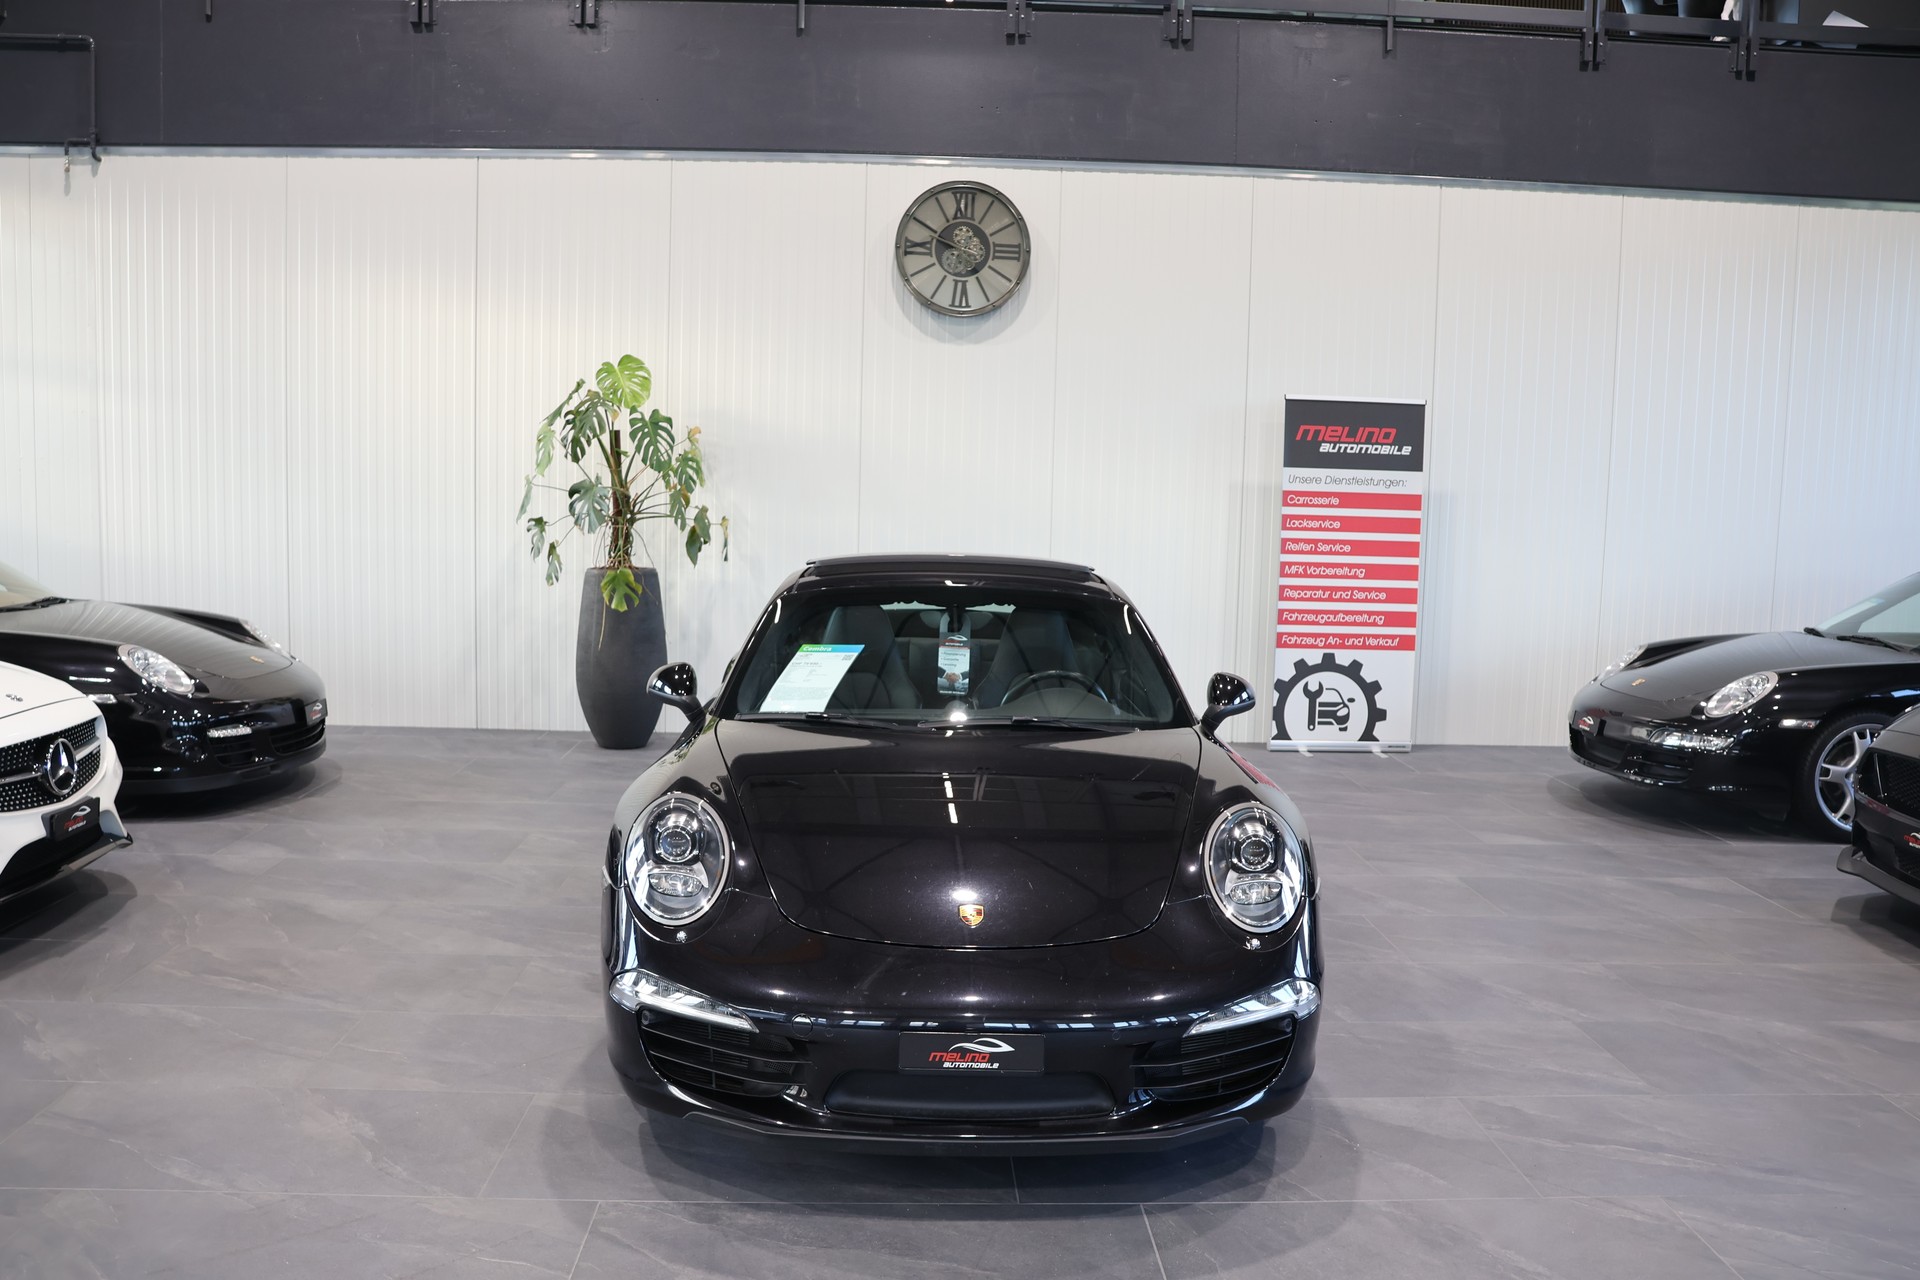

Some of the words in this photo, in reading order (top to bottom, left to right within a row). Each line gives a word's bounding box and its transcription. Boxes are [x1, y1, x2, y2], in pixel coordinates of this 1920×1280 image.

[951, 191, 977, 221] XII
[1288, 474, 1322, 485] Unsere
[1324, 475, 1408, 489] Dienstleistungen:
[1287, 494, 1340, 506] Carrosserie
[1286, 518, 1341, 529] Lackservice
[1285, 541, 1315, 552] Reifen
[1316, 542, 1351, 553] Service
[1284, 565, 1305, 575] MFK
[1306, 566, 1366, 578] Vorbereitung
[1283, 588, 1331, 600] Reparatur
[1332, 590, 1351, 600] und
[1352, 590, 1387, 600] Service
[1282, 612, 1385, 625] Fahrzeugaufbereitung
[1281, 635, 1325, 648] Fahrzeug
[1326, 636, 1343, 646] An-
[1344, 637, 1364, 647] und
[1365, 637, 1399, 647] Verkauf
